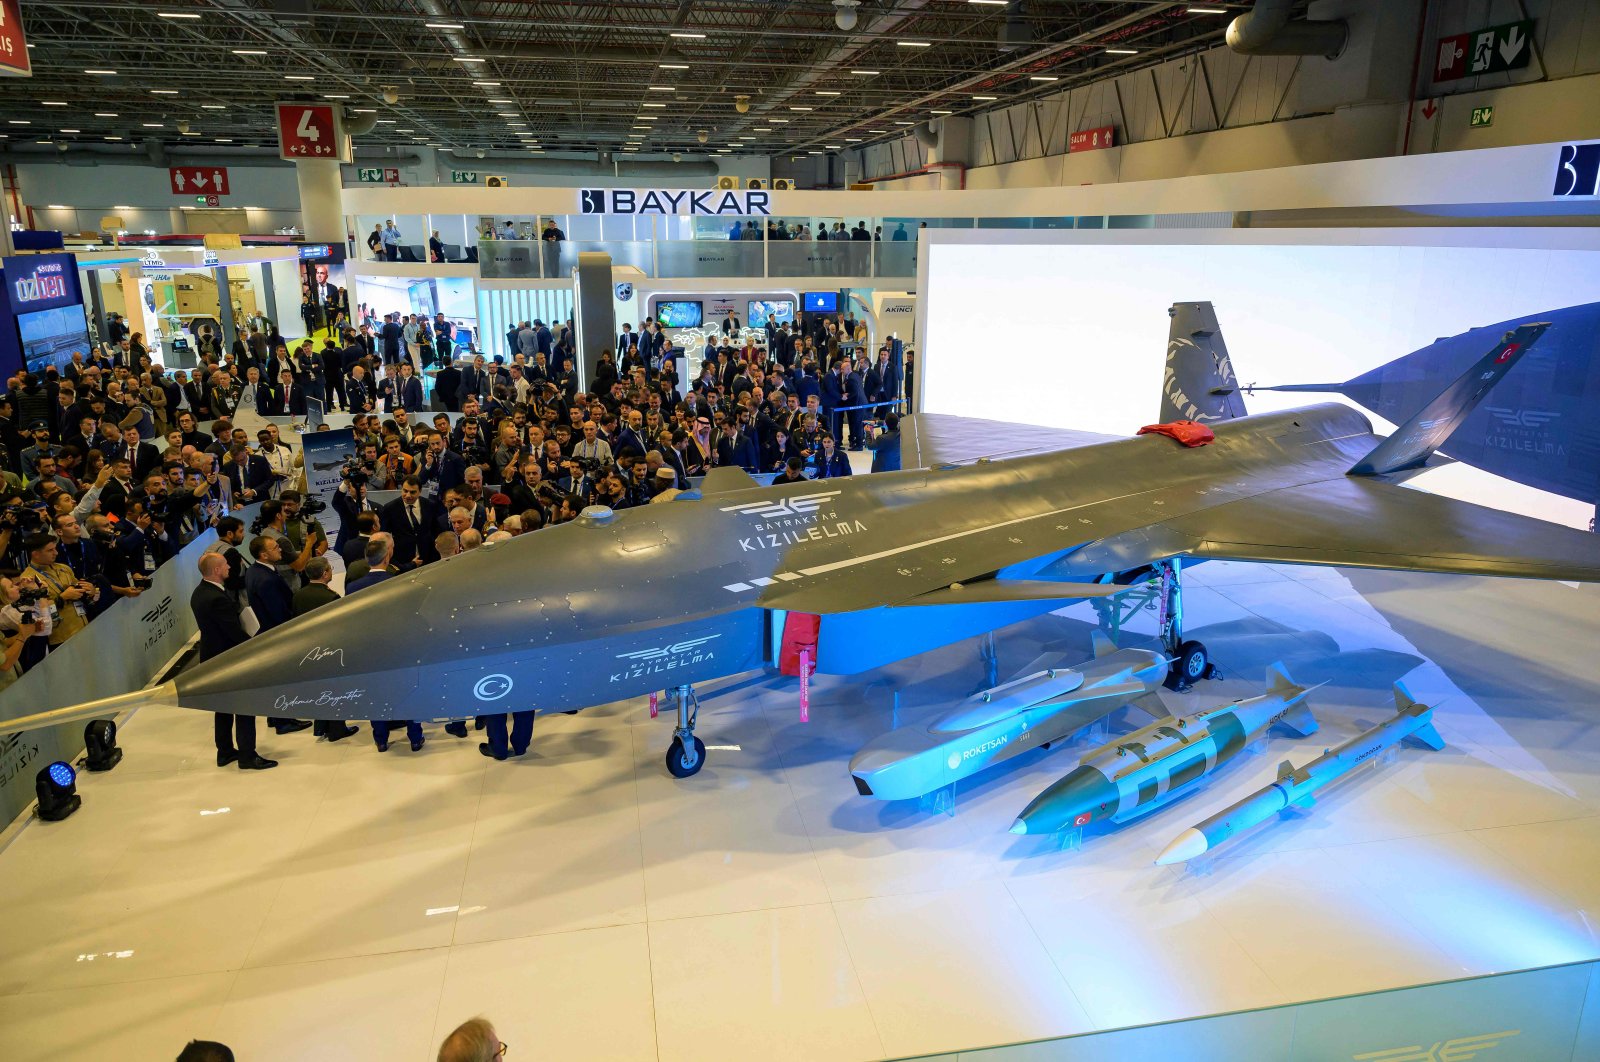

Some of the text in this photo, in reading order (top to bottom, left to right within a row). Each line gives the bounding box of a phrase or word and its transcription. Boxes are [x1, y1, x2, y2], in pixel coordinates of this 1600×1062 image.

[0, 35, 13, 57] IŞ
[297, 110, 320, 141] 4
[300, 145, 321, 154] 2 8
[1071, 132, 1098, 146] SALON 8
[612, 190, 770, 215] BAYKAR
[1485, 436, 1565, 455] KIZILELMA
[755, 512, 838, 532] BAYRAKTAR
[738, 520, 868, 552] KIZILELMA
[609, 652, 714, 683] KIZILELMA
[630, 650, 701, 669] BAYRAKTAR
[963, 734, 1008, 761] ROKETSAN
